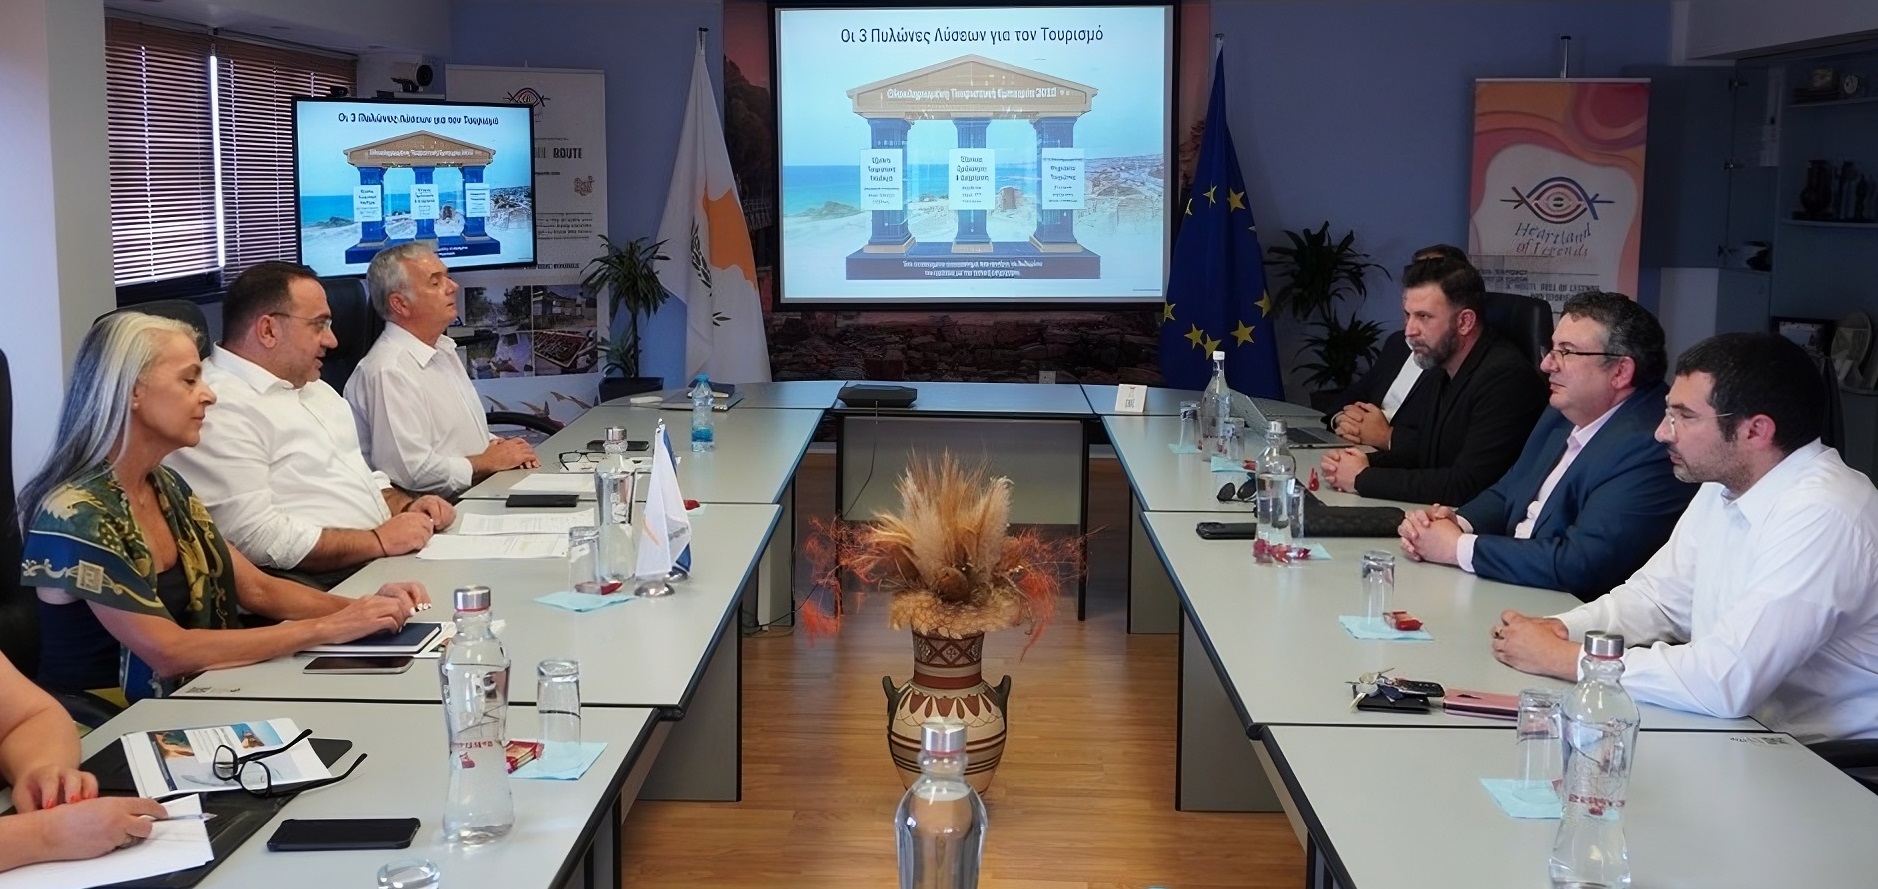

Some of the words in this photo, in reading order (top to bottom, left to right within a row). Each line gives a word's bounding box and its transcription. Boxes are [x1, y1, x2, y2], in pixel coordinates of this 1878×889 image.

[841, 29, 856, 43] Οι
[858, 29, 868, 43] 3
[871, 27, 931, 45] Πυλώνες
[934, 27, 987, 43] Λύσεων
[990, 30, 1011, 46] για
[1014, 30, 1037, 43] τον
[1040, 25, 1104, 45] Τουρισμό
[1515, 221, 1592, 246] Heartland
